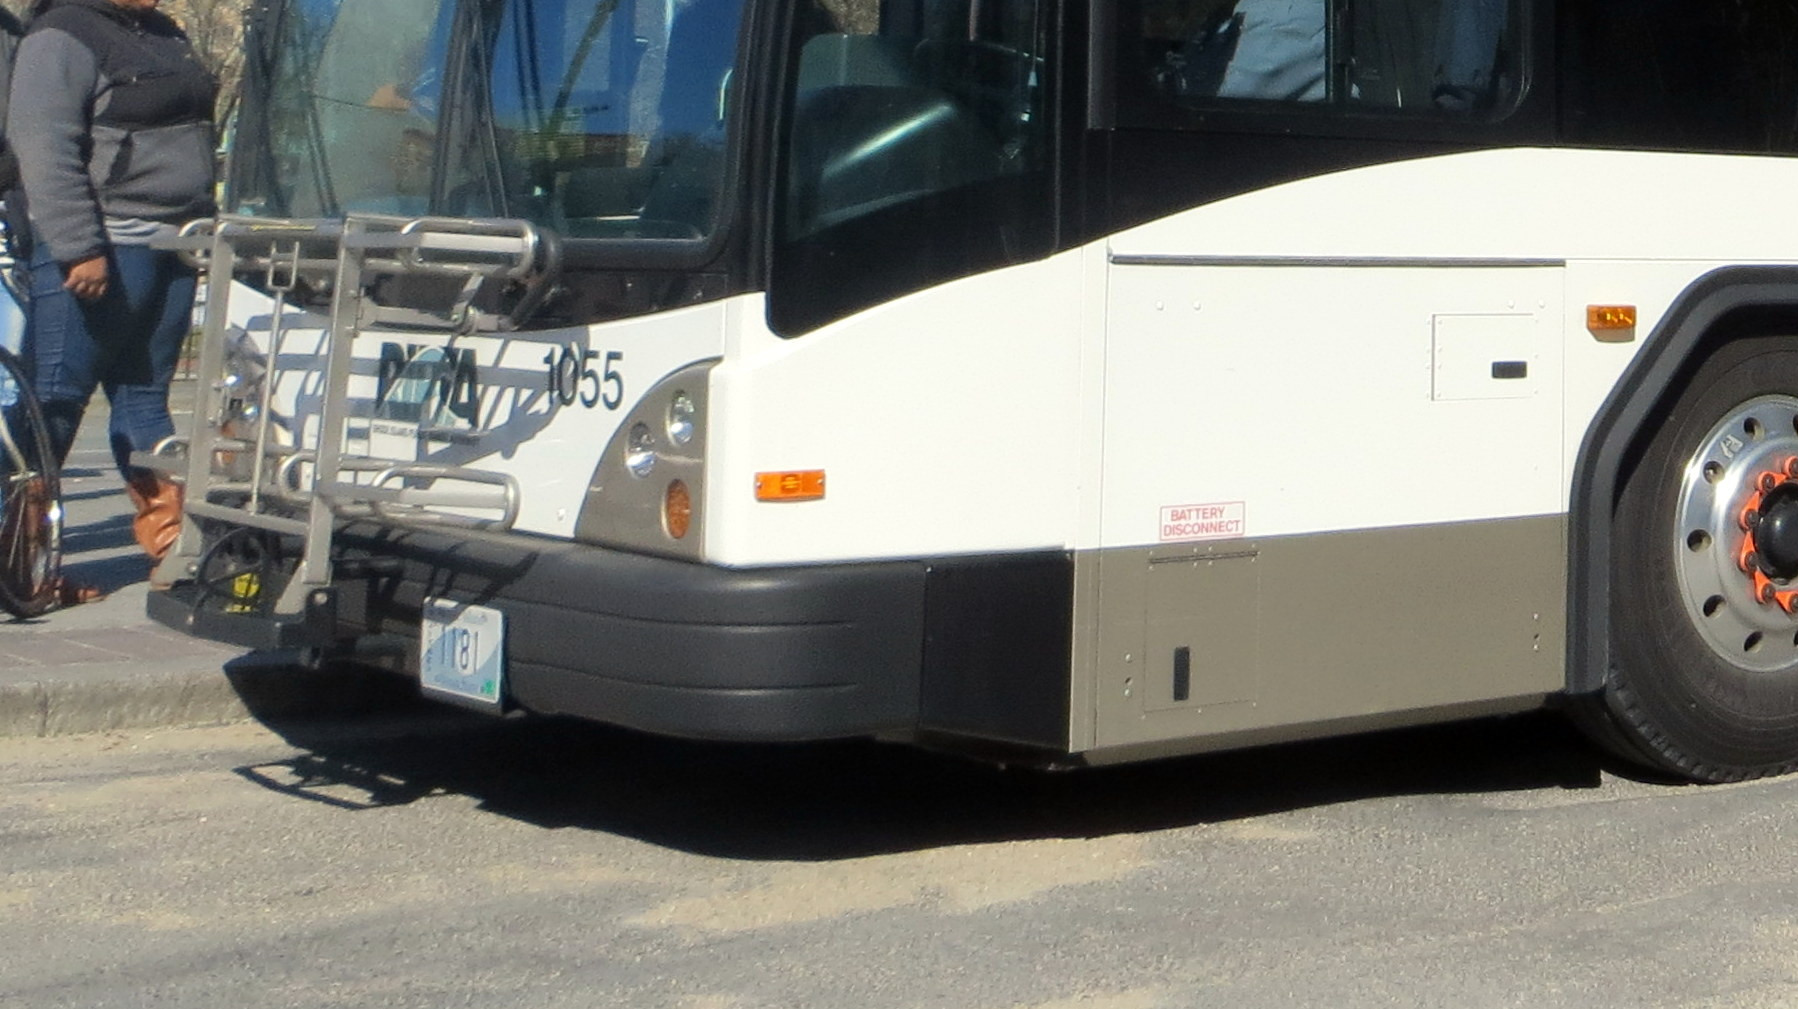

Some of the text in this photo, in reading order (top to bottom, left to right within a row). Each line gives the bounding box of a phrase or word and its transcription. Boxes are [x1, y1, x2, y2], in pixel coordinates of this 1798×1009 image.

[543, 346, 624, 410] 1055
[1171, 507, 1225, 521] BATTERY
[1164, 520, 1241, 537] DISCONNECT
